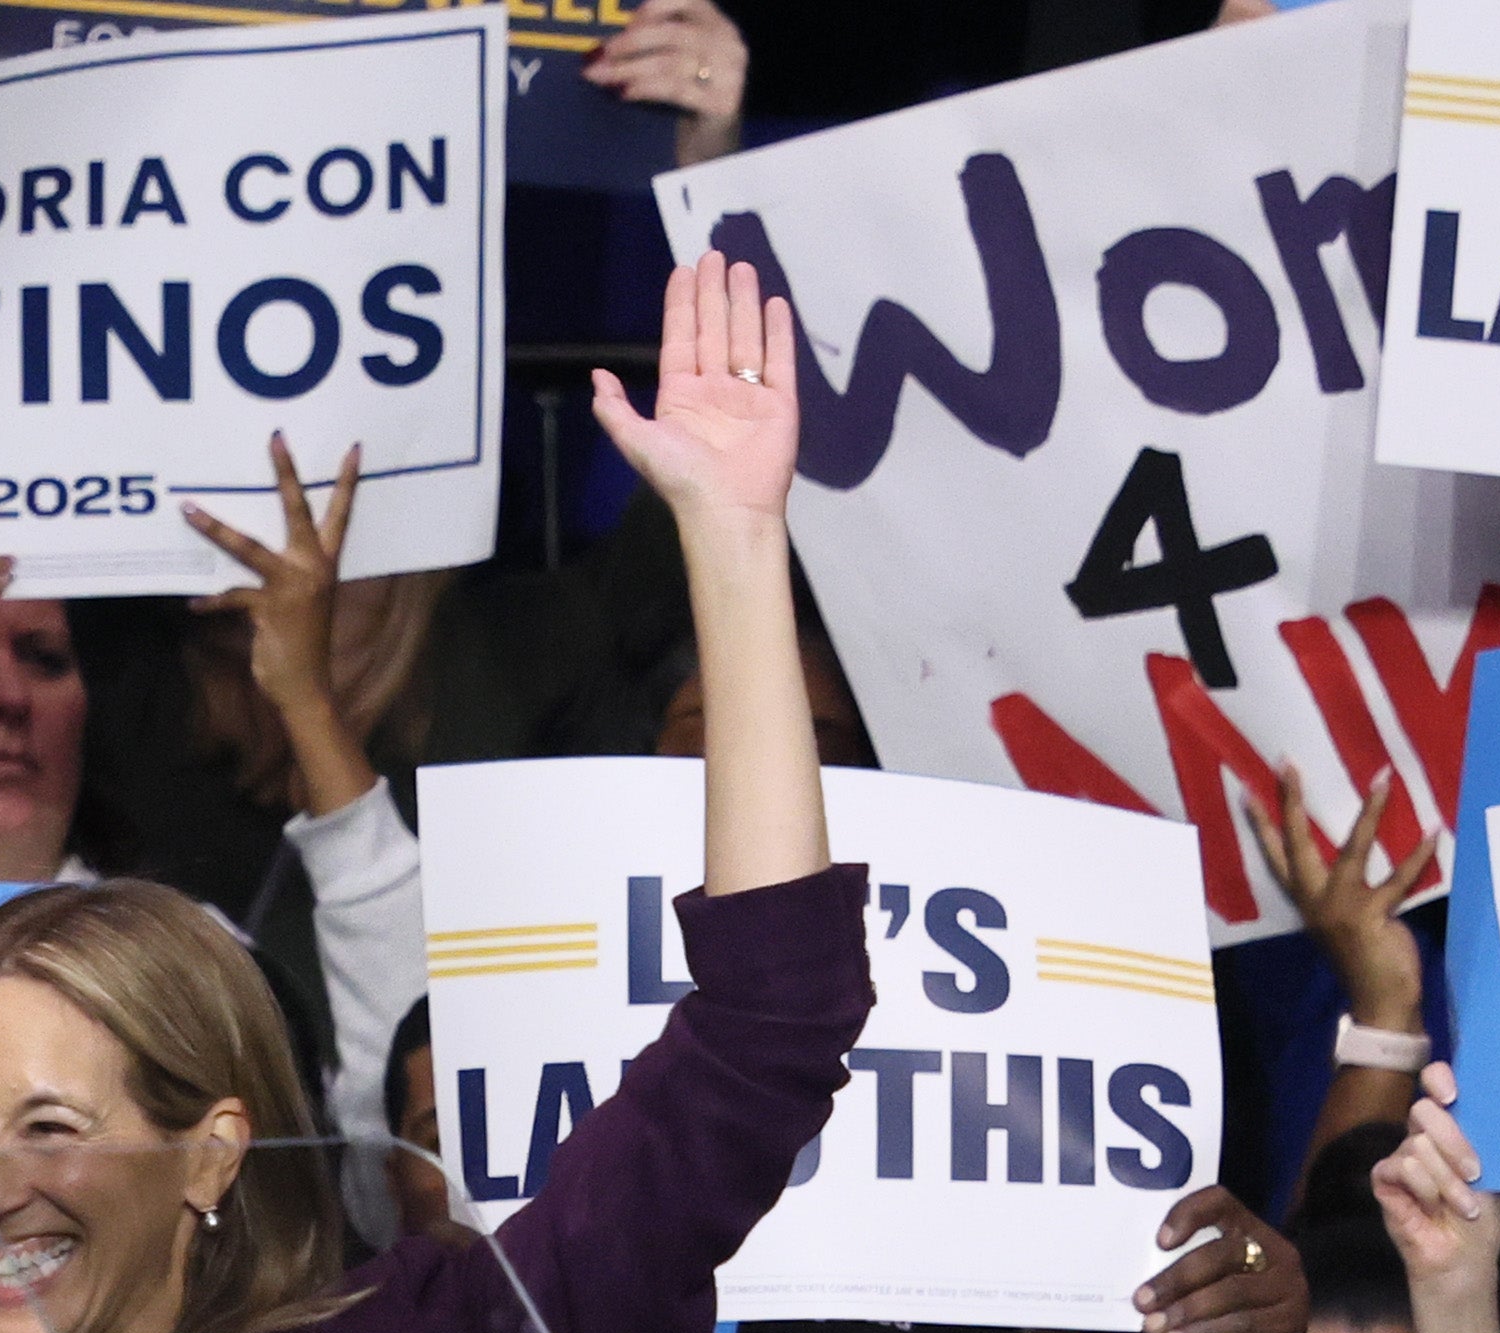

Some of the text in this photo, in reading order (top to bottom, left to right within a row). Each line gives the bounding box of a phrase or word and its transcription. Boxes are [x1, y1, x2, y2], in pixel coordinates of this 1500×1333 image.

[223, 137, 449, 224] CON
[1064, 446, 1279, 689] 4
[850, 1048, 1193, 1191] THIS
